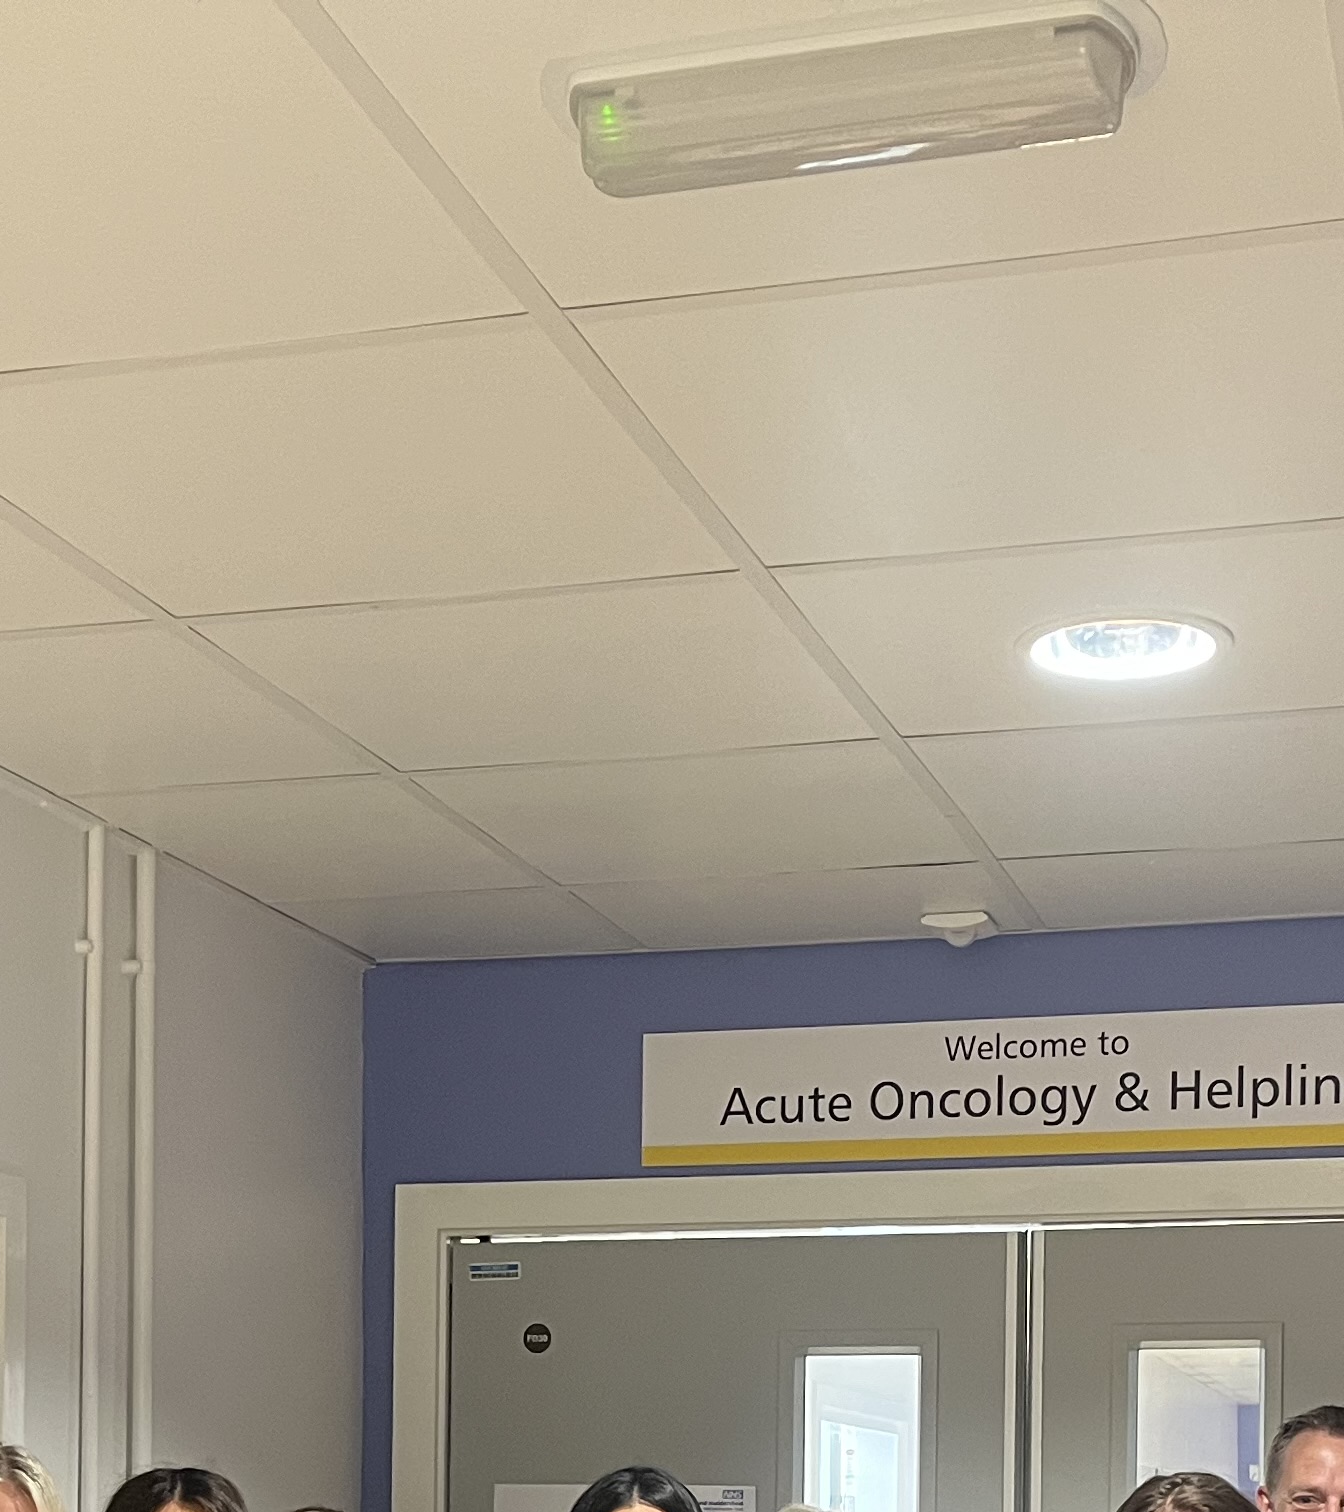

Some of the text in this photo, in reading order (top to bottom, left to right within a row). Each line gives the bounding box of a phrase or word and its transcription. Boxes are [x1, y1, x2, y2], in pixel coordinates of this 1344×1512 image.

[944, 1031, 1129, 1062] Welcome to
[719, 1086, 852, 1126] Acute
[870, 1074, 1097, 1126] Oncology
[1115, 1071, 1150, 1112] &
